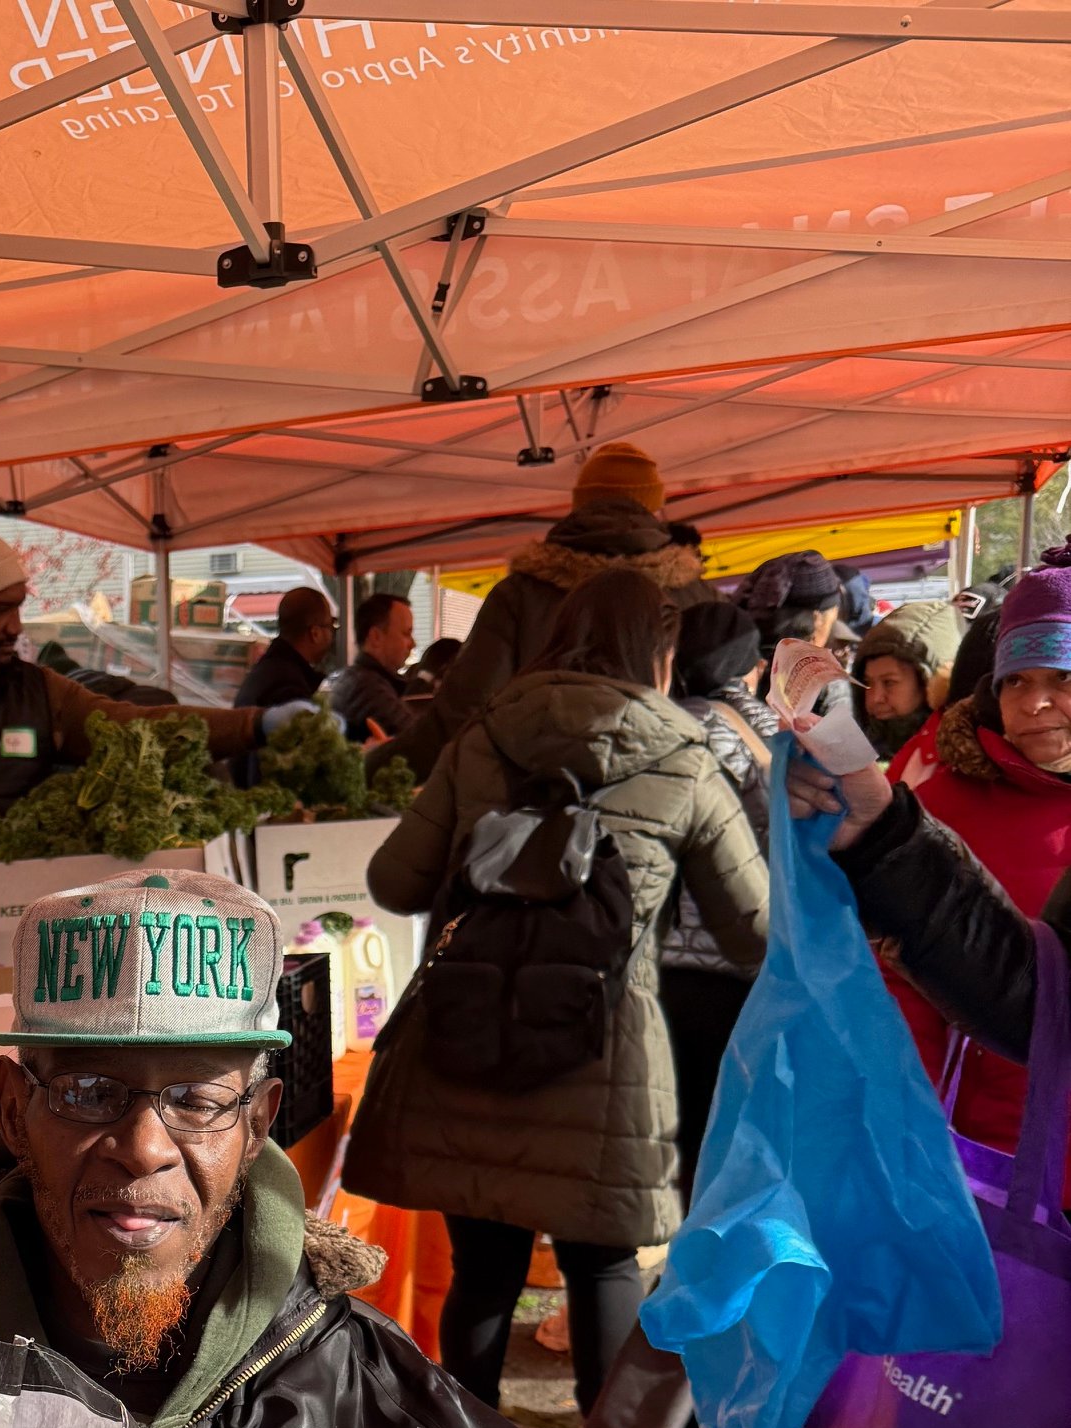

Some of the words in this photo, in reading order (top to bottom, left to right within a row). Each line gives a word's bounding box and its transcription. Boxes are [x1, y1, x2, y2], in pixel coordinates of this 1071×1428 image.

[0, 905, 28, 918] KEE
[34, 912, 132, 1003] NEW
[140, 910, 255, 1001] YORK
